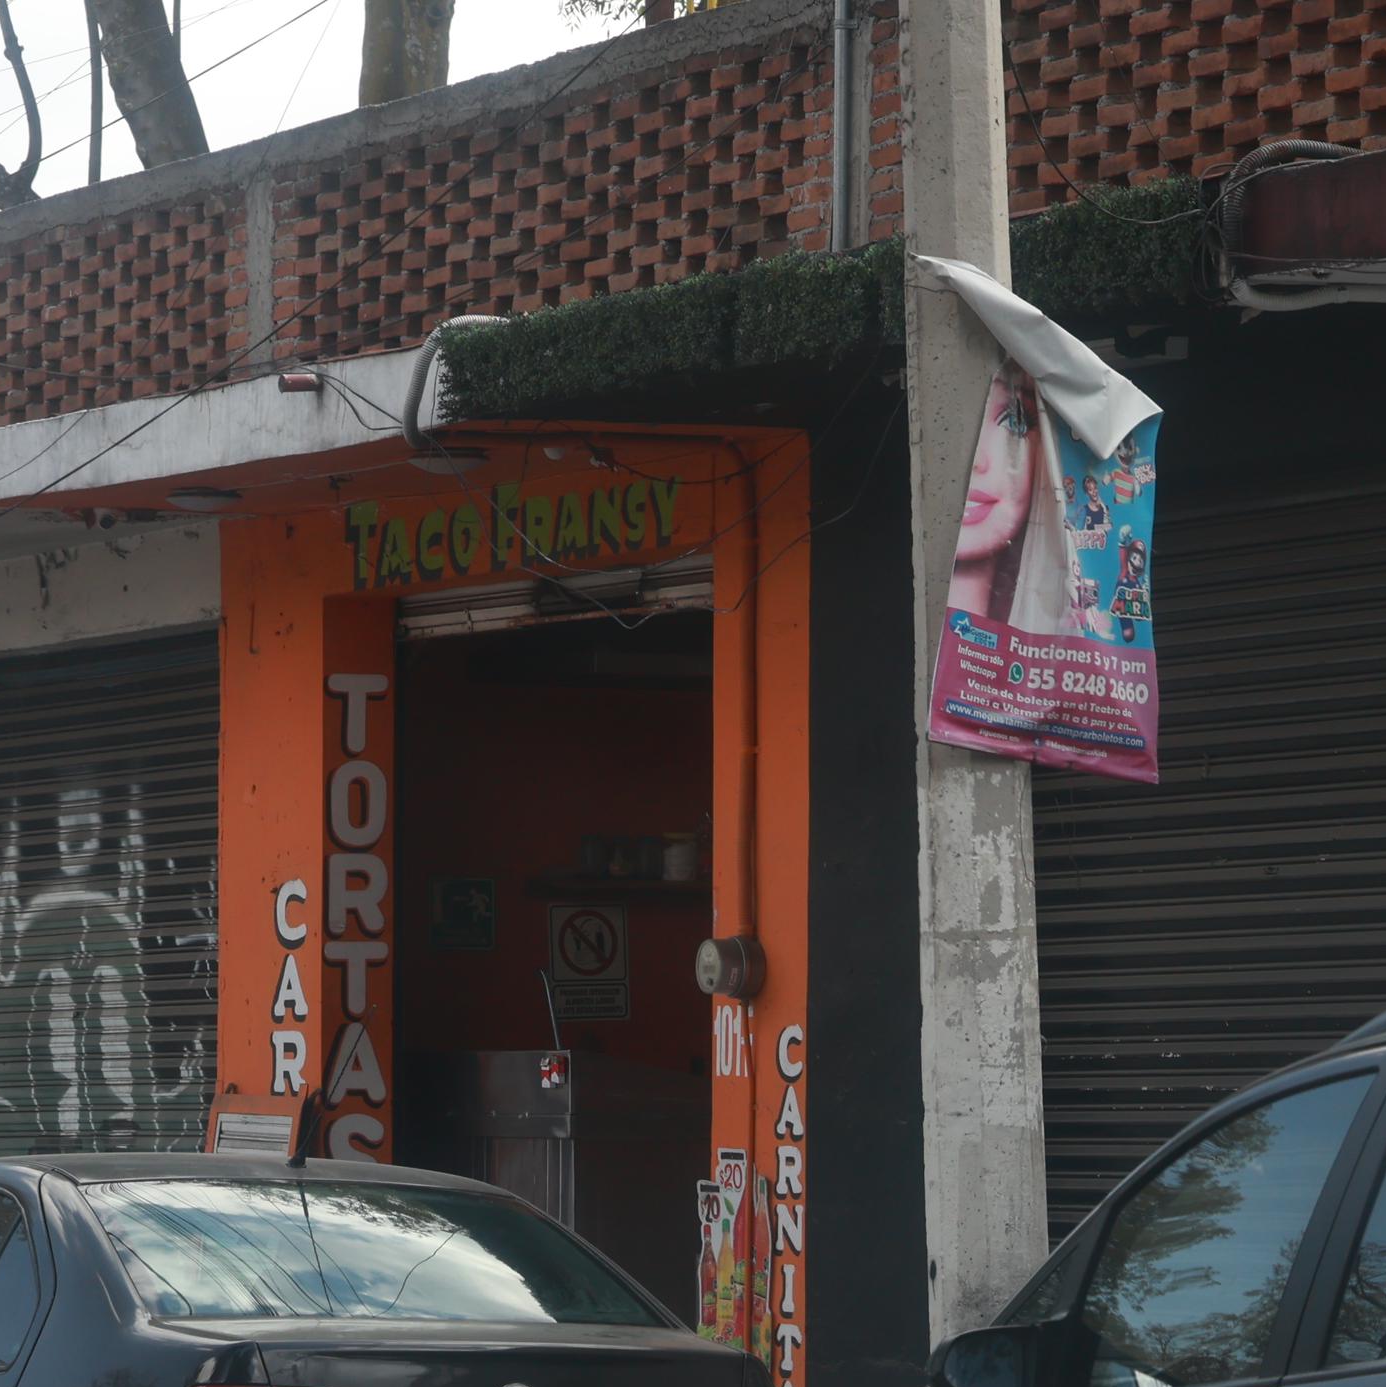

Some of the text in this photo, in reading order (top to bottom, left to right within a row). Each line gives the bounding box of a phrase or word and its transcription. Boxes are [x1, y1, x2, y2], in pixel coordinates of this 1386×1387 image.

[347, 476, 682, 588] TACO FRANSY
[1111, 599, 1151, 619] MARIO
[959, 658, 998, 680] Whatsapp
[1009, 636, 1092, 665] Funciones
[1093, 650, 1102, 665] 5
[1111, 655, 1119, 670] 7
[1122, 660, 1147, 676] pm
[967, 678, 1133, 719] Venta de boletos en el Teatro de
[1027, 666, 1150, 705] 55 8248 2660
[959, 690, 991, 707] Lunes
[992, 701, 1000, 711] a
[1002, 702, 1046, 720] Viernes
[1072, 714, 1080, 724] a
[1081, 714, 1089, 725] 6
[1089, 717, 1107, 729] pm
[1107, 720, 1115, 731] y
[326, 672, 390, 1162] TORTAS
[719, 1162, 745, 1193] $20
